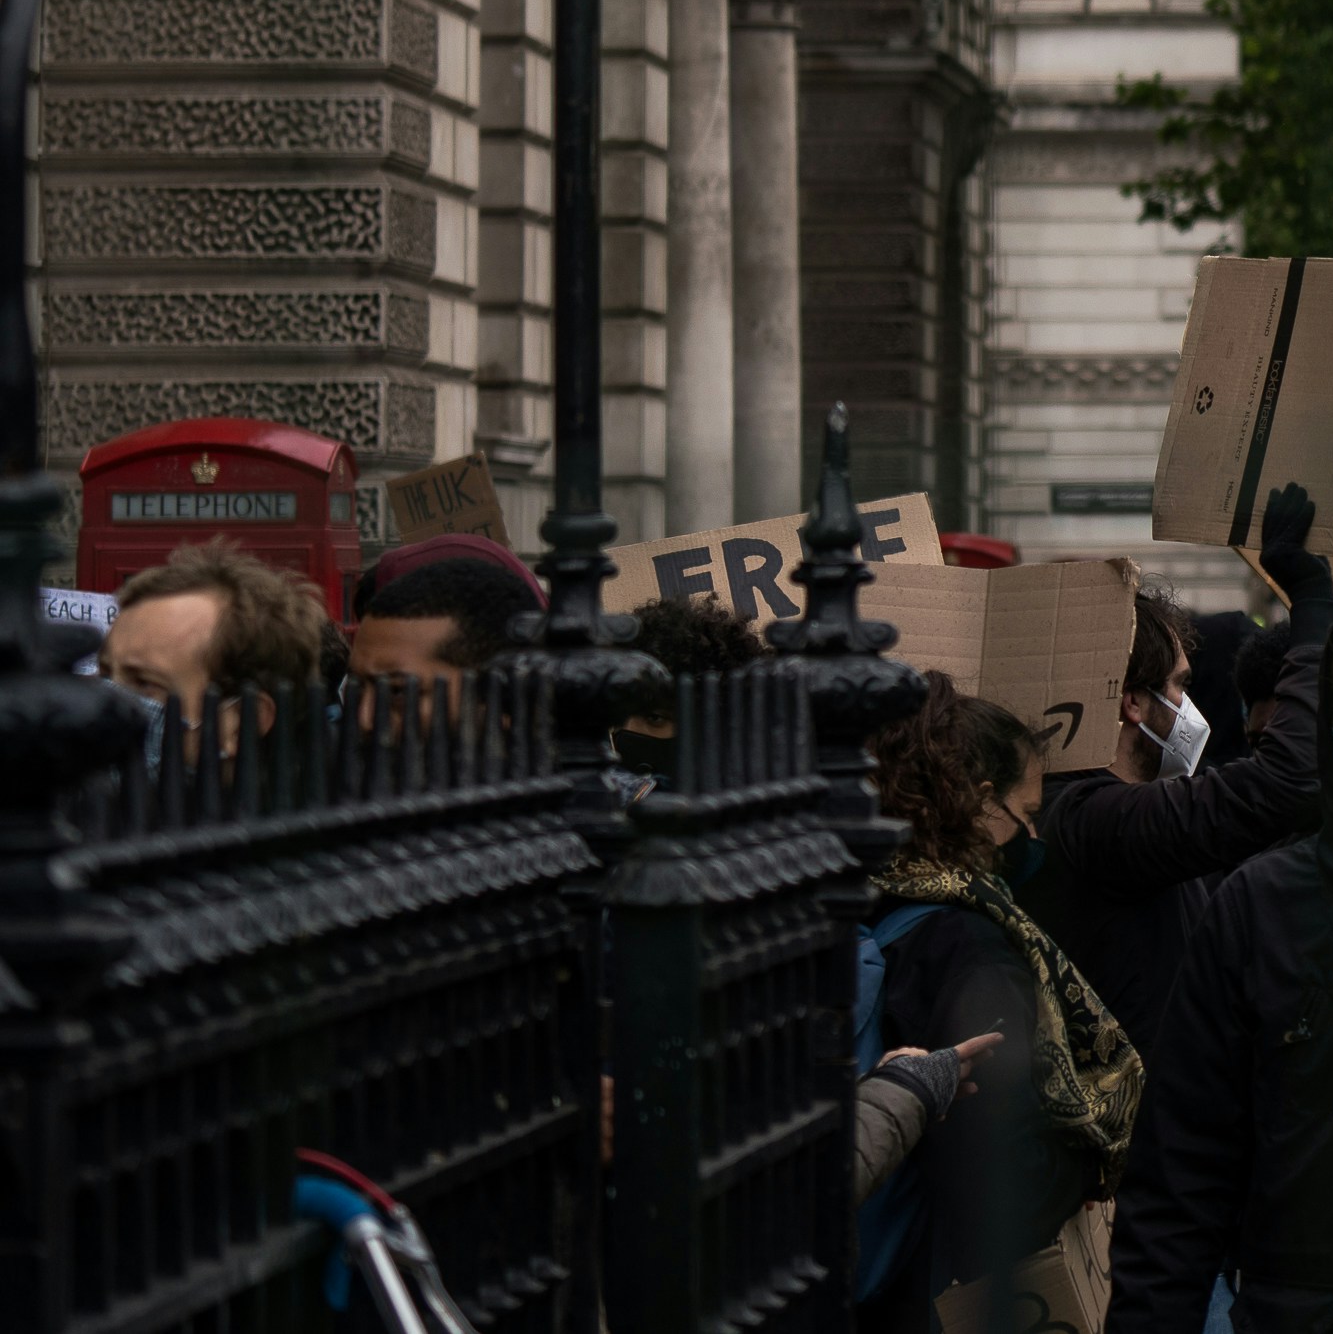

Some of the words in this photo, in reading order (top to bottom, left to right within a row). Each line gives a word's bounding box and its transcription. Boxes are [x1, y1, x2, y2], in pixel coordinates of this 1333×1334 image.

[1263, 287, 1279, 338] MANKIND
[1249, 355, 1265, 408] BEAUTY
[120, 492, 288, 519] TELEPHONE
[396, 479, 437, 525] THE
